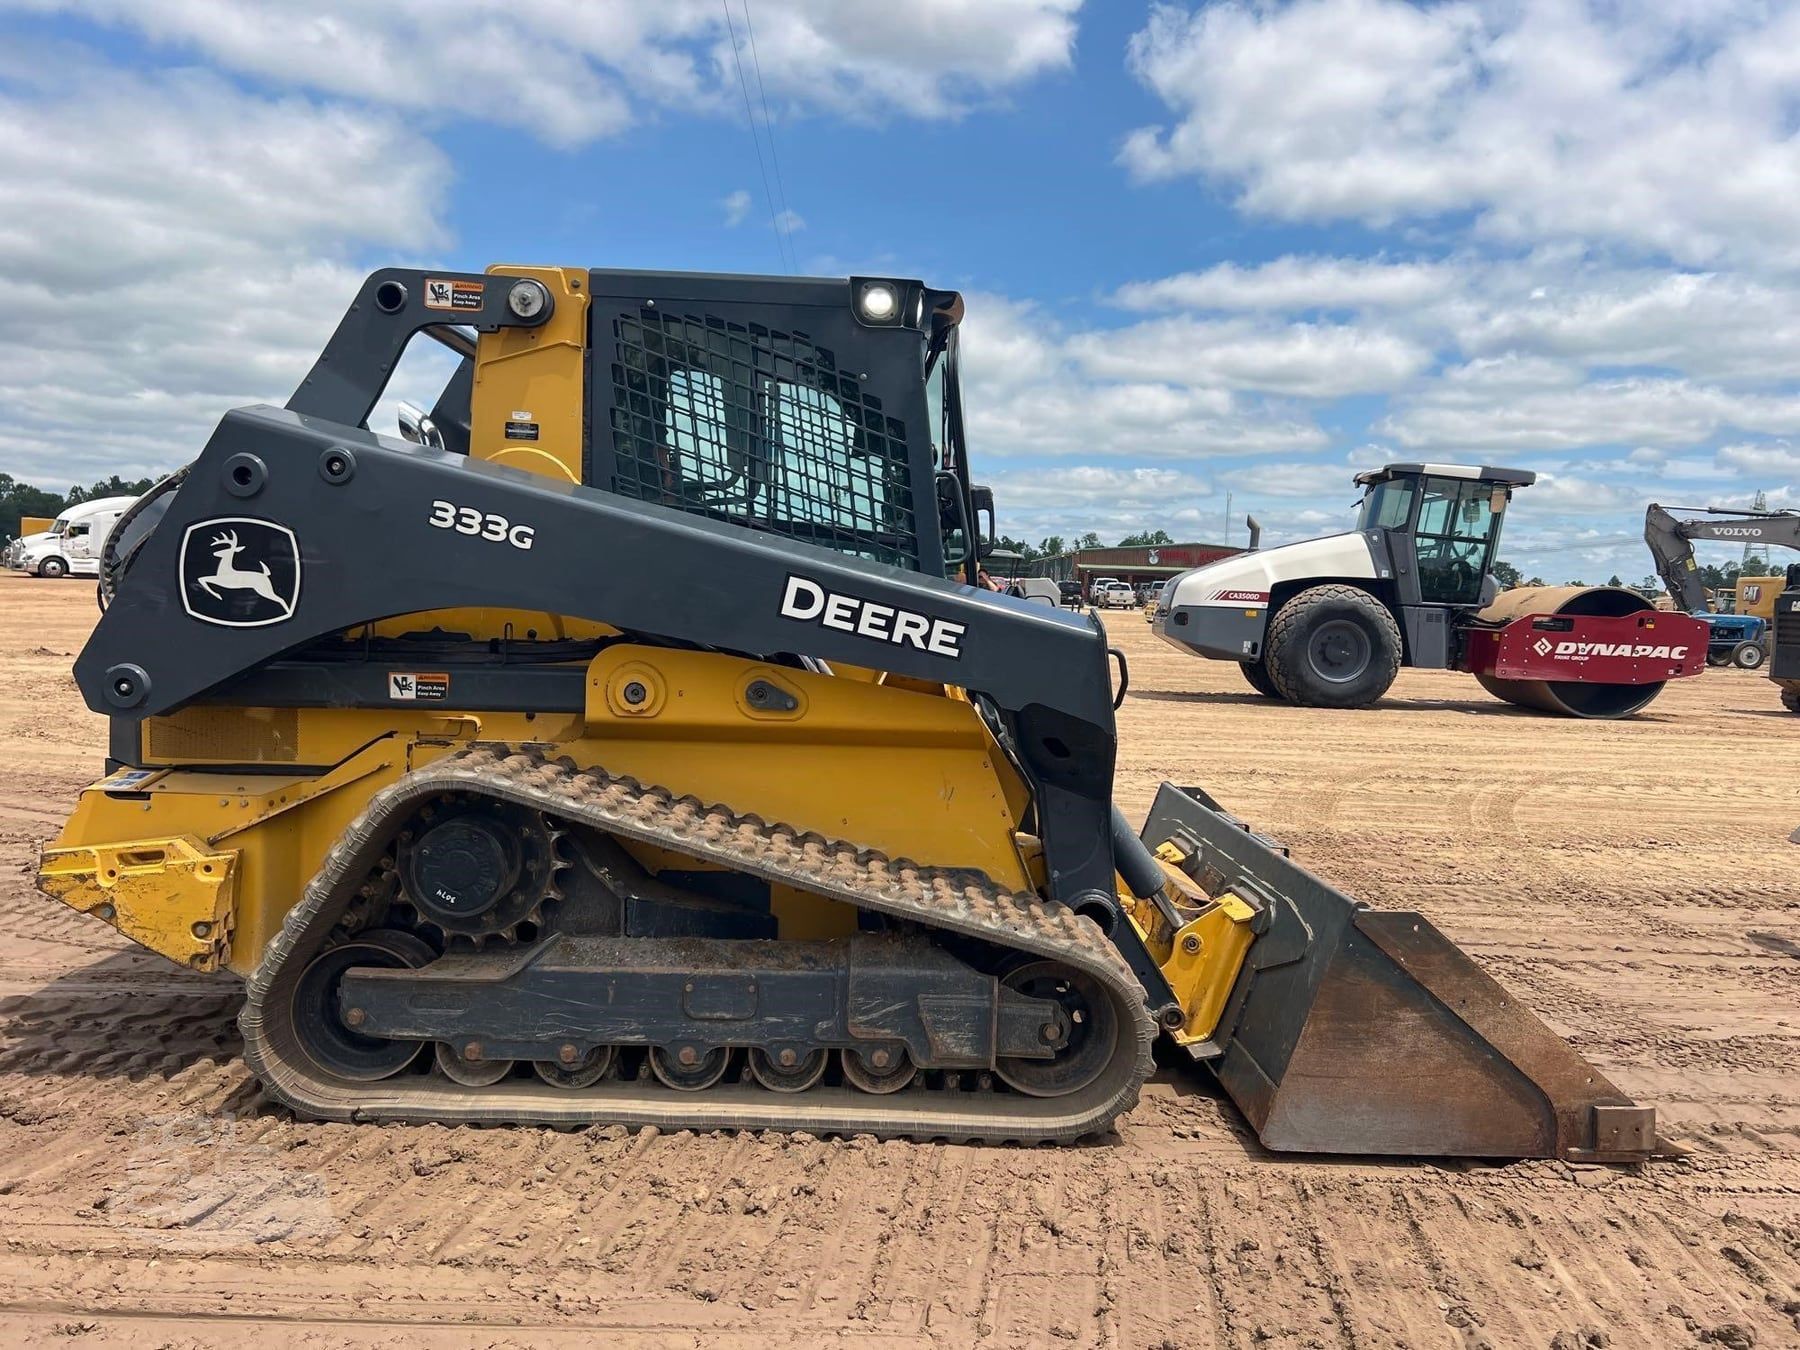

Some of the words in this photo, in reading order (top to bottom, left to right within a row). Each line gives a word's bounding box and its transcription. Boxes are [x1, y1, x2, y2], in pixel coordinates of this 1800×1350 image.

[428, 499, 536, 550] 333G
[1711, 527, 1763, 536] VOLVO
[1743, 584, 1760, 601] CAT
[780, 575, 966, 658] DEERE
[1554, 641, 1689, 660] DYNAPAC
